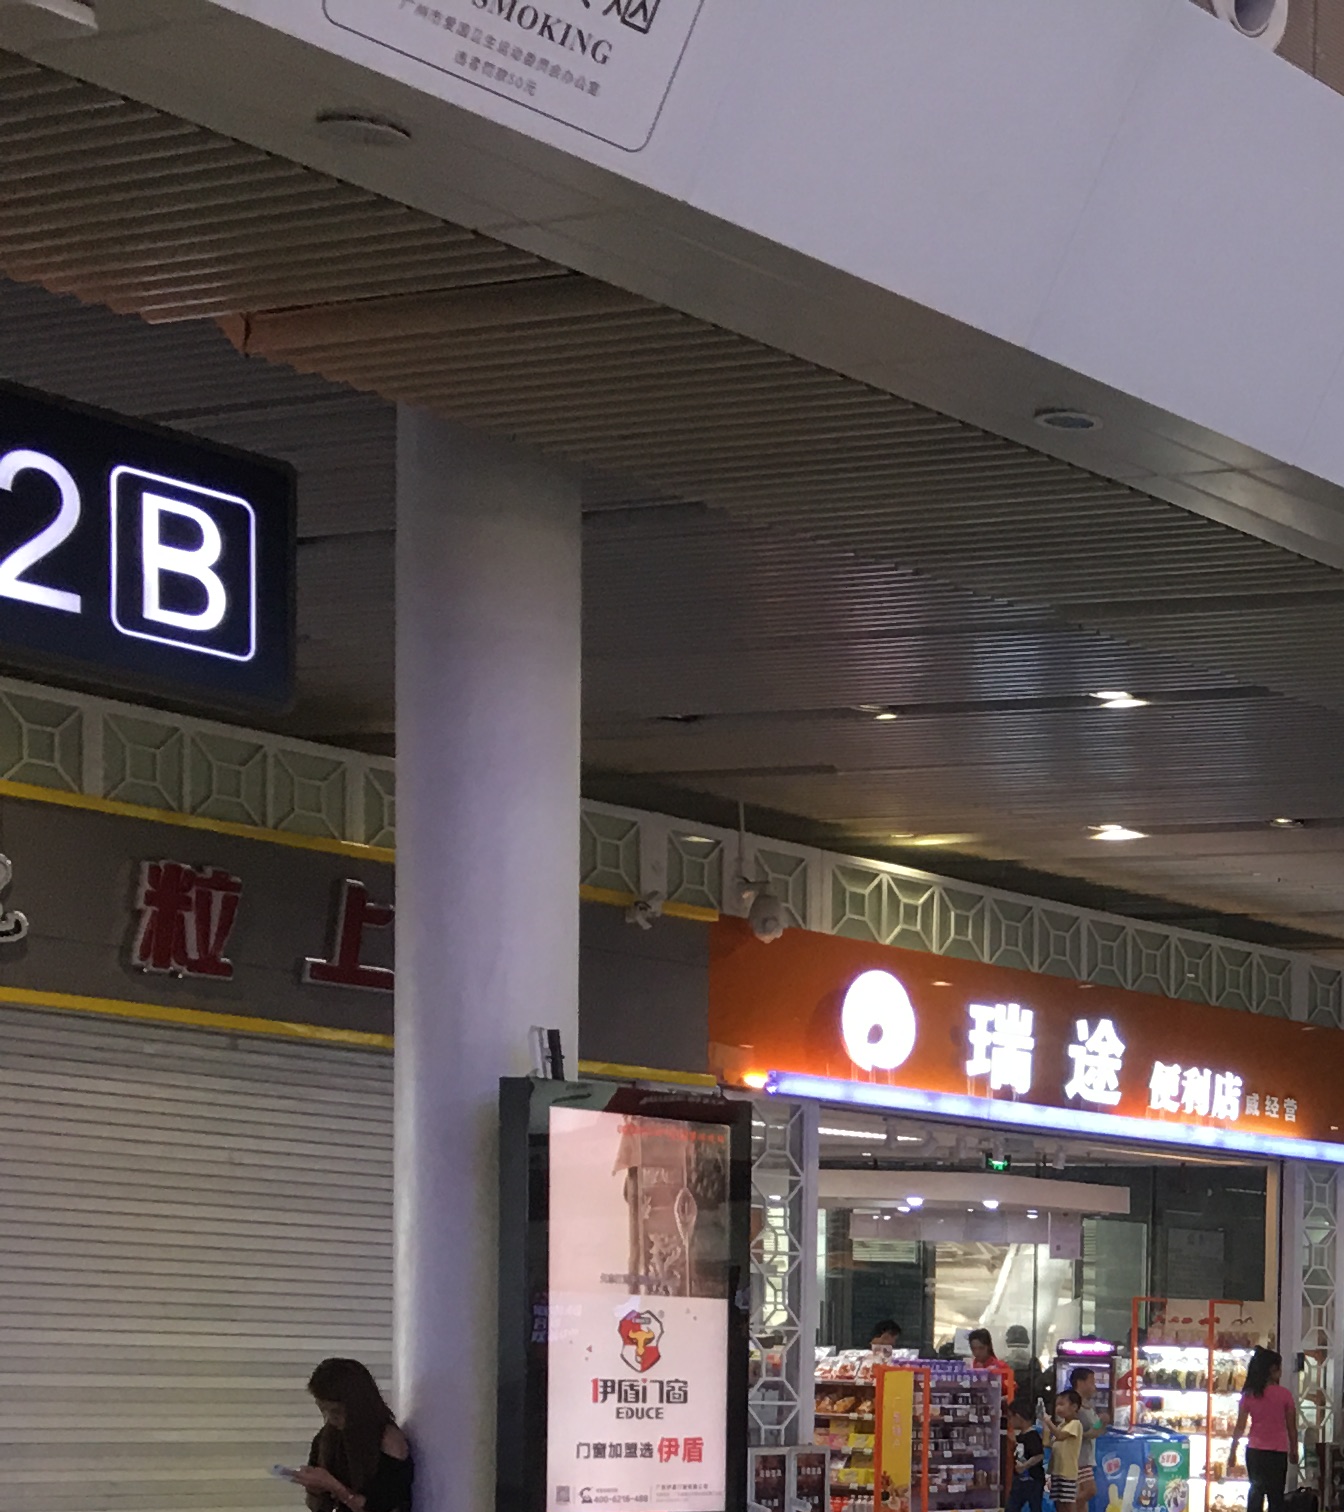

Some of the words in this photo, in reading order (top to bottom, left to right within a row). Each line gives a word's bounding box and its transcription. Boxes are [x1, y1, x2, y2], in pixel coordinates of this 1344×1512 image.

[965, 1002, 1127, 1105] 瑞途
[1149, 1060, 1243, 1121] 便利店
[591, 1377, 688, 1405] 伊盾门窗
[615, 1406, 665, 1420] EDUCE
